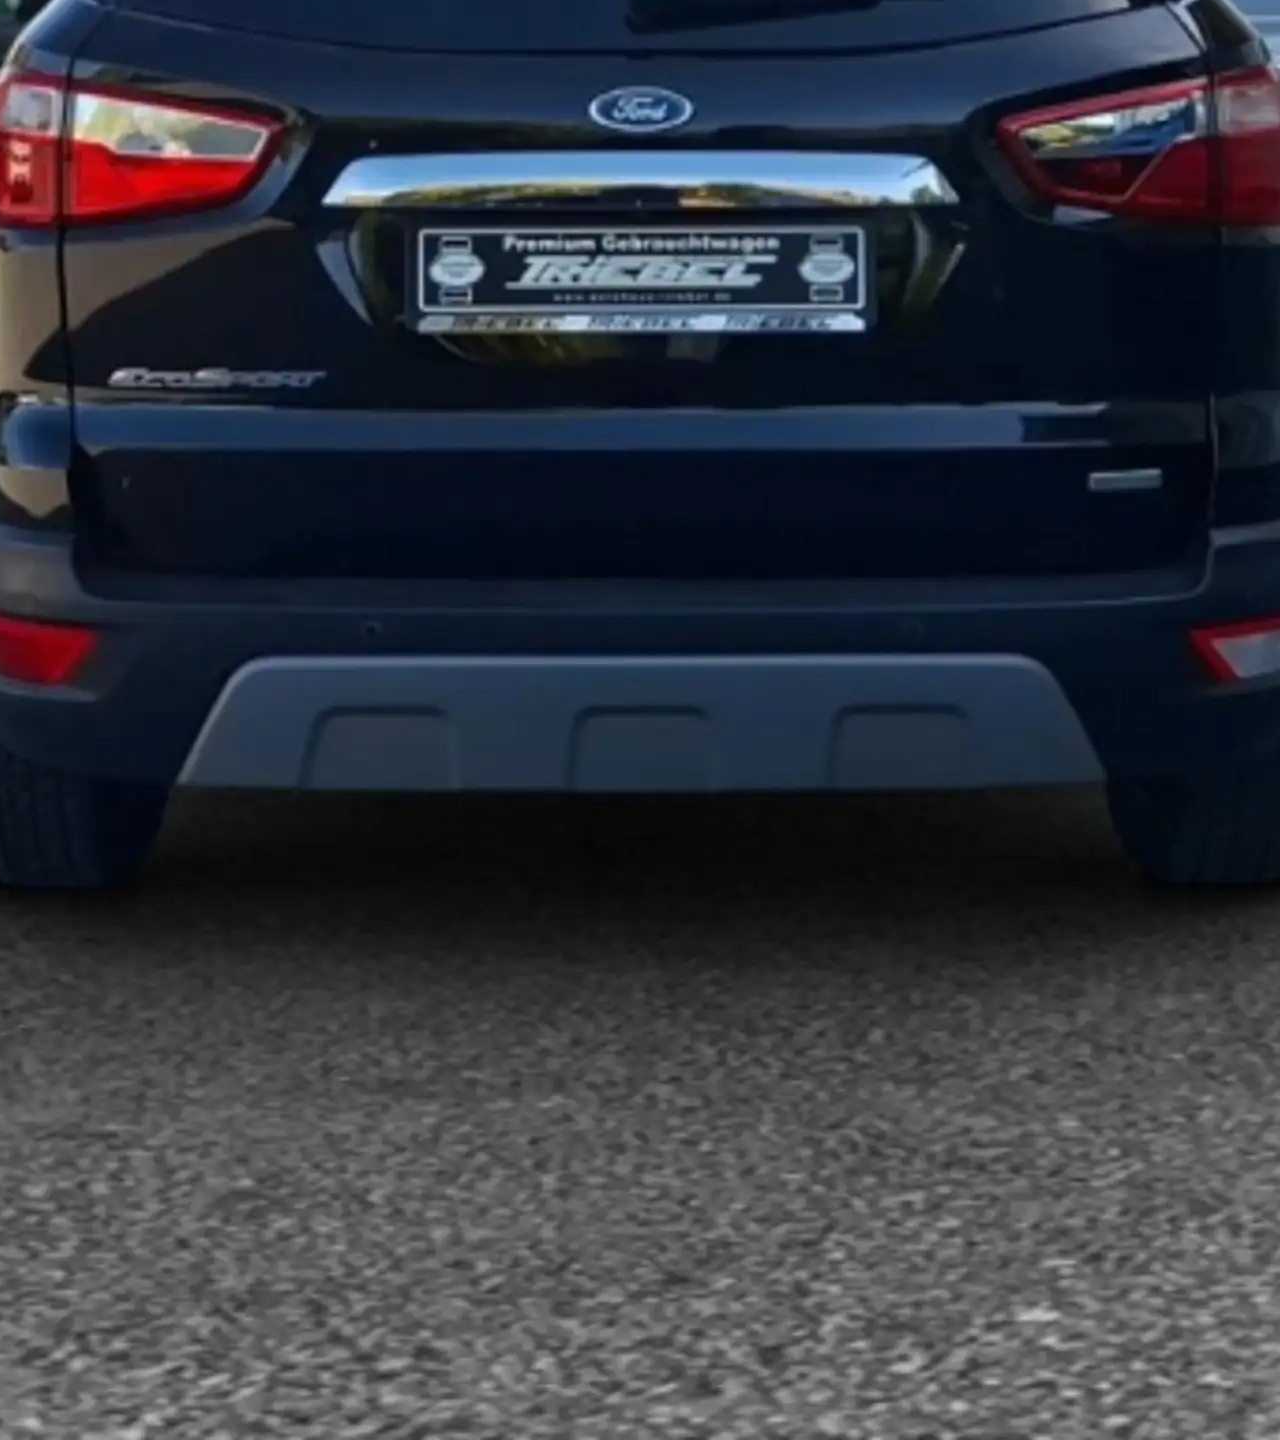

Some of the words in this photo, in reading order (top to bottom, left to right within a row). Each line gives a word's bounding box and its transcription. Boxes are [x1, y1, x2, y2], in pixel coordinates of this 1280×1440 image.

[503, 235, 596, 252] Premium
[601, 235, 780, 253] Gebrauchtwagen
[504, 255, 777, 289] TRIEBEL
